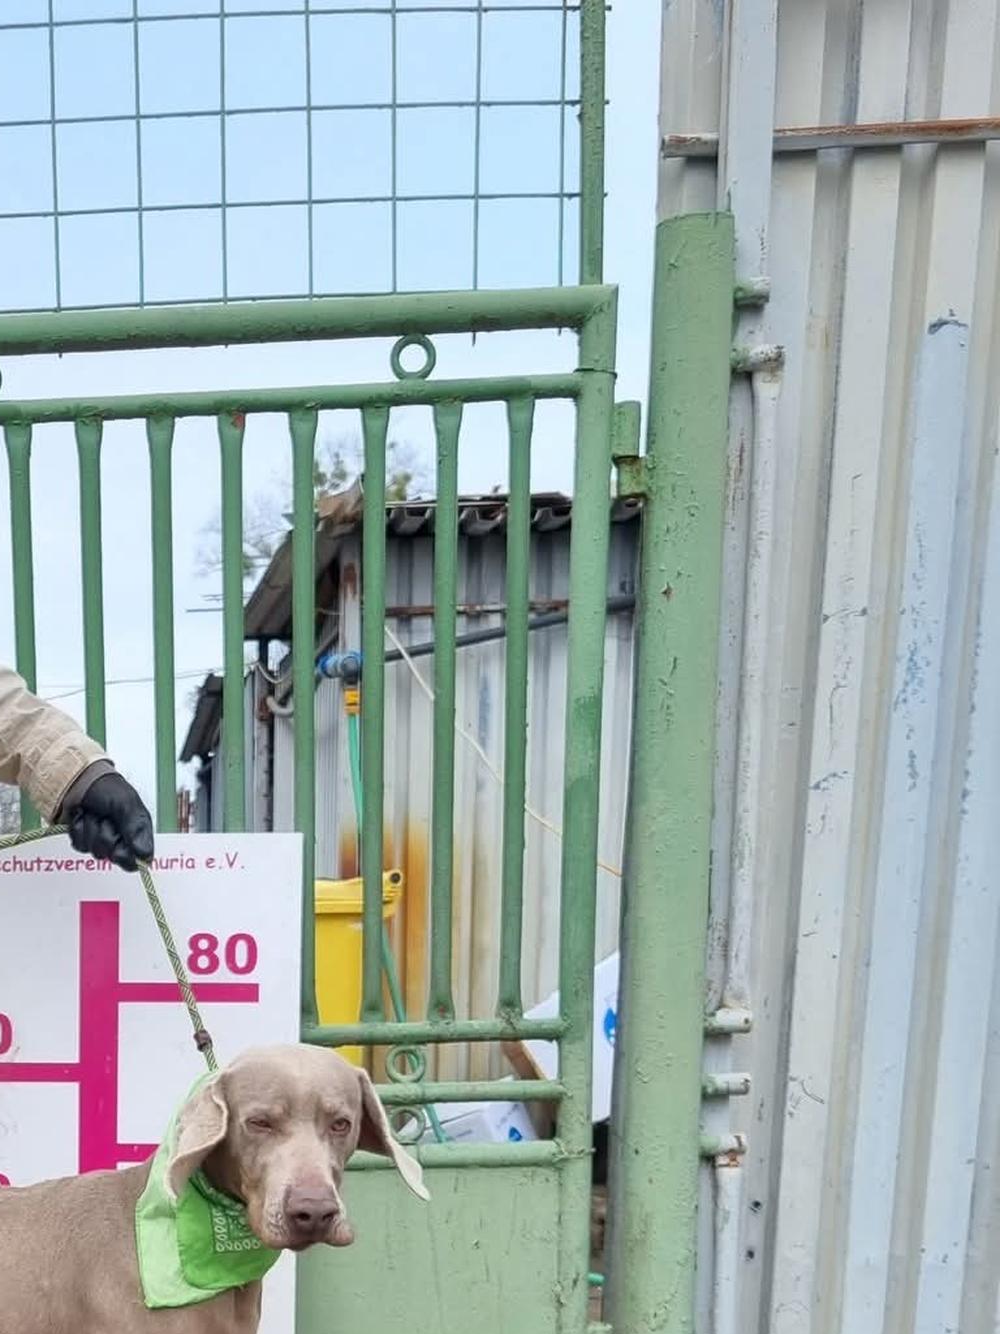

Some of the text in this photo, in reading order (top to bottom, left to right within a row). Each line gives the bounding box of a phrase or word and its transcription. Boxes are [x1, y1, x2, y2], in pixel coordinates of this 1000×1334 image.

[151, 854, 195, 871] nuria
[205, 851, 245, 870] e.V.
[187, 933, 258, 975] 80
